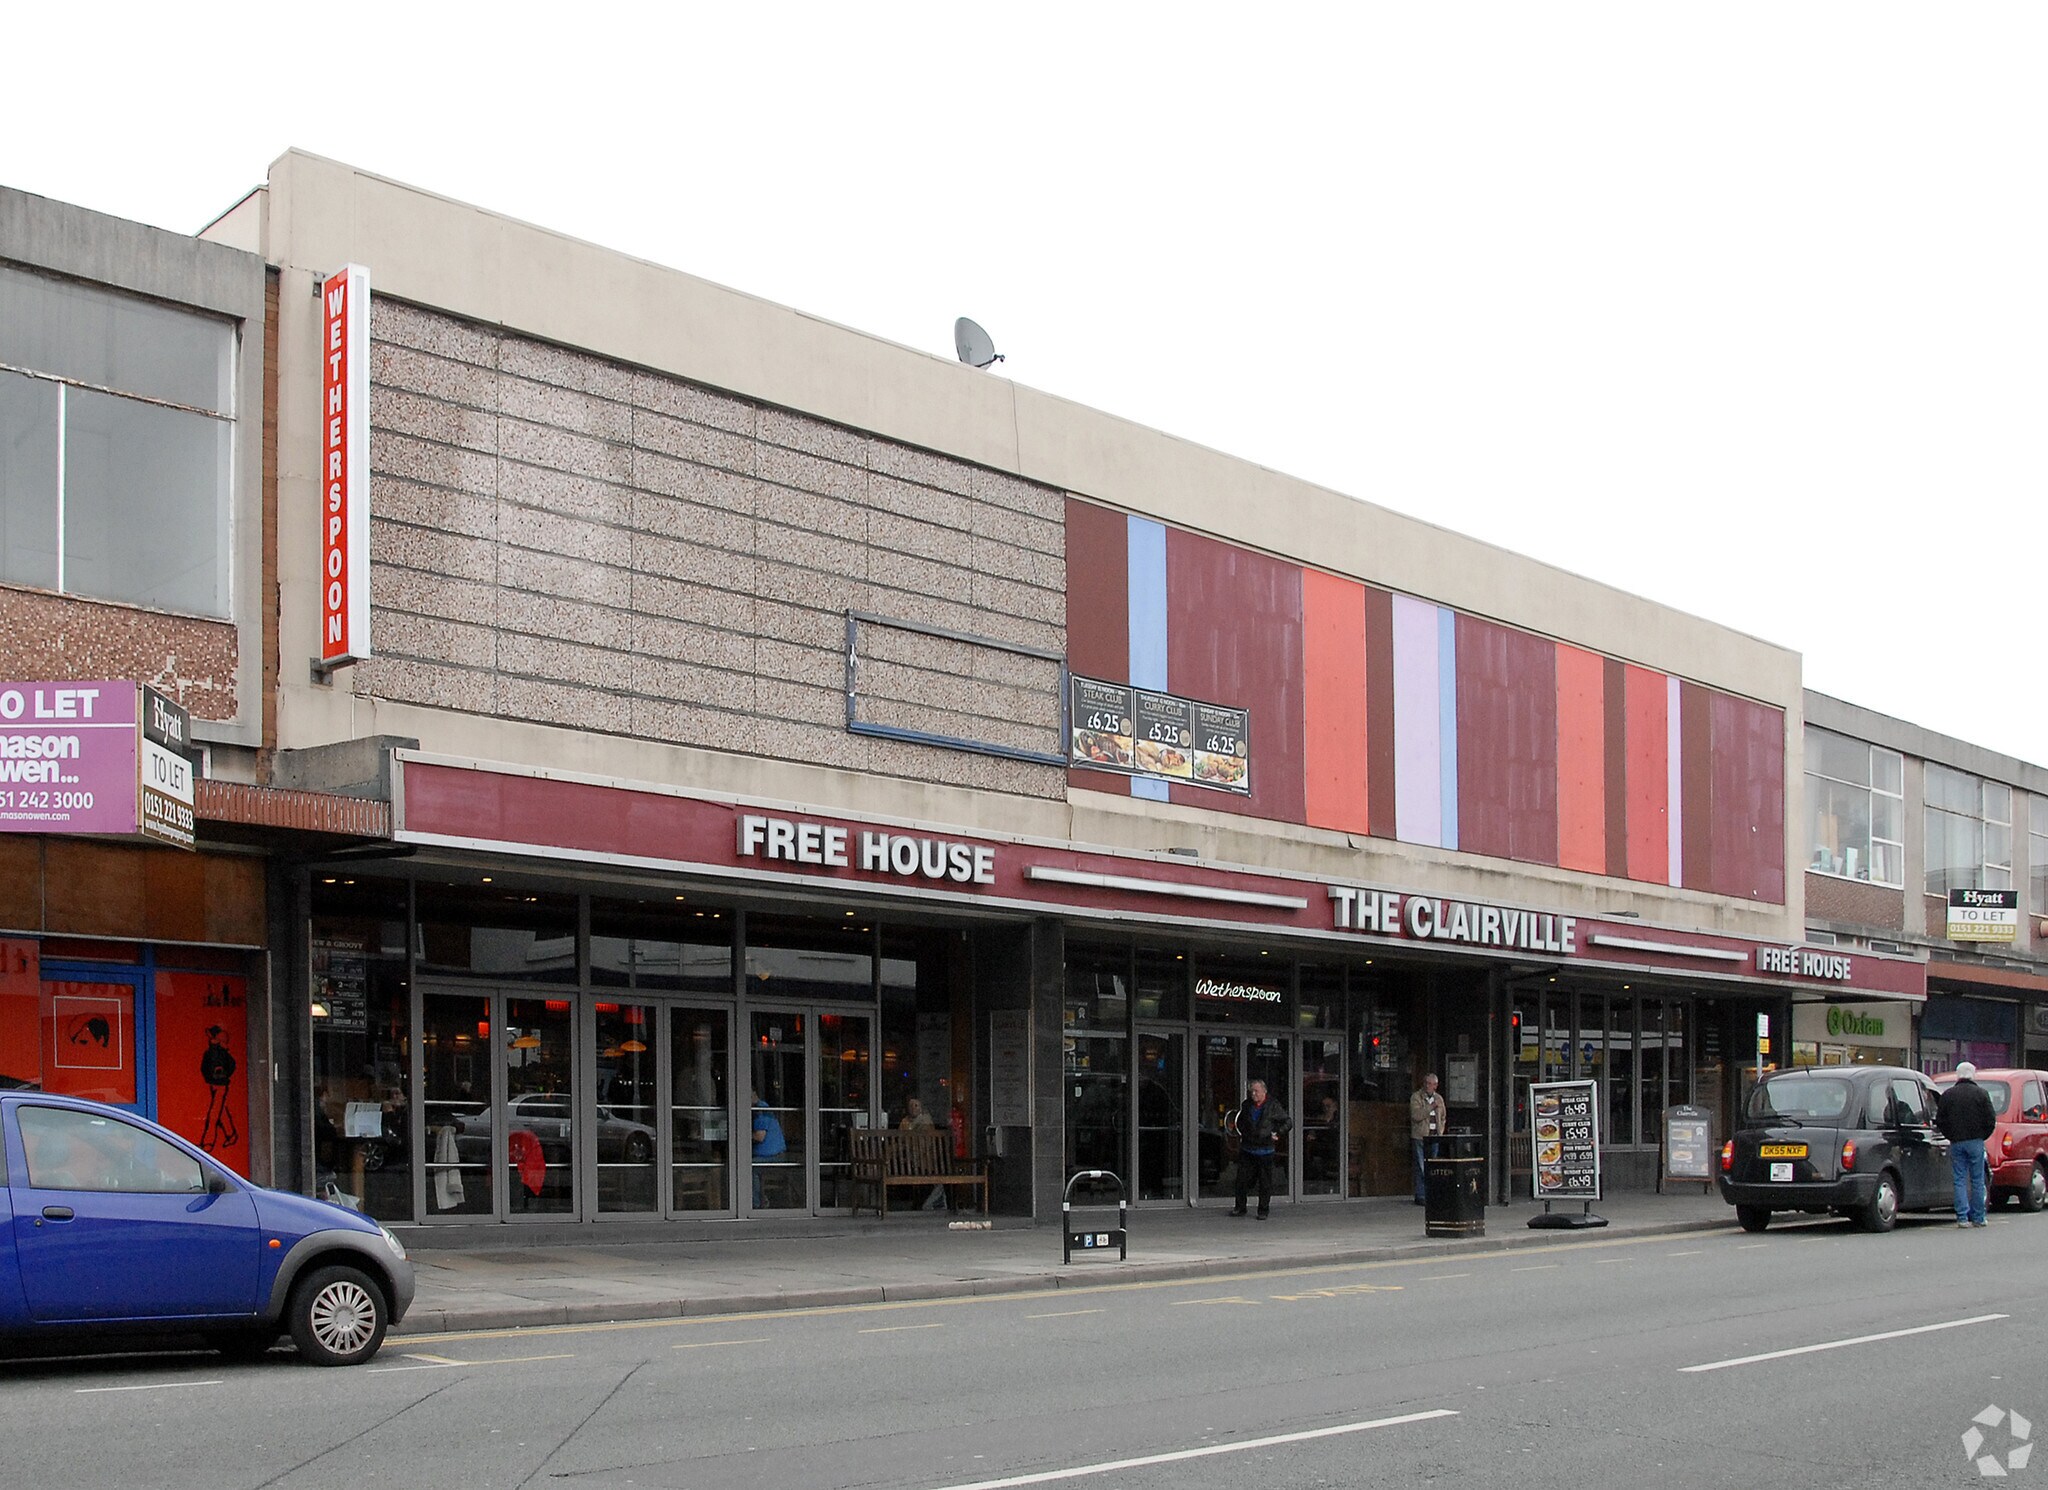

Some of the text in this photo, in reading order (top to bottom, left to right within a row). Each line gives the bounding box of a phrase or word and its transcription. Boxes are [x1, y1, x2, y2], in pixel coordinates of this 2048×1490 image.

[326, 284, 345, 645] WETHERSPOON
[34, 688, 100, 719] LET
[1083, 689, 1104, 700] STEAK
[1105, 693, 1123, 704] CLUB
[1144, 702, 1165, 712] CURRY
[1166, 705, 1182, 716] CLUB
[153, 696, 182, 744] Hyatt
[1087, 711, 1119, 733] £6.25
[1200, 713, 1224, 724] SUNDAY
[1224, 717, 1240, 727] CLUB
[1149, 722, 1179, 743] £5.25
[1206, 734, 1235, 754] £6.25
[152, 753, 185, 792] TO LET
[19, 791, 49, 809] 242
[53, 791, 94, 809] 3000
[144, 792, 194, 831] 0151 221 9333
[738, 814, 995, 884] FREE HOUSE
[1963, 890, 2004, 907] Hyatt
[1329, 886, 1576, 953] THE CLAIRVILLE
[1961, 910, 2005, 921] TO LET
[1950, 924, 2014, 934] 0151 221 9333
[1758, 947, 1851, 980] FREE HOUSE
[1195, 979, 1281, 1003] Wetherspoon
[1841, 1009, 1884, 1036] Oxfam
[1564, 1103, 1587, 1115] £6.49
[1565, 1127, 1588, 1139] £5.49
[1786, 1146, 1803, 1155] NXF
[1568, 1175, 1591, 1187] £6.49
